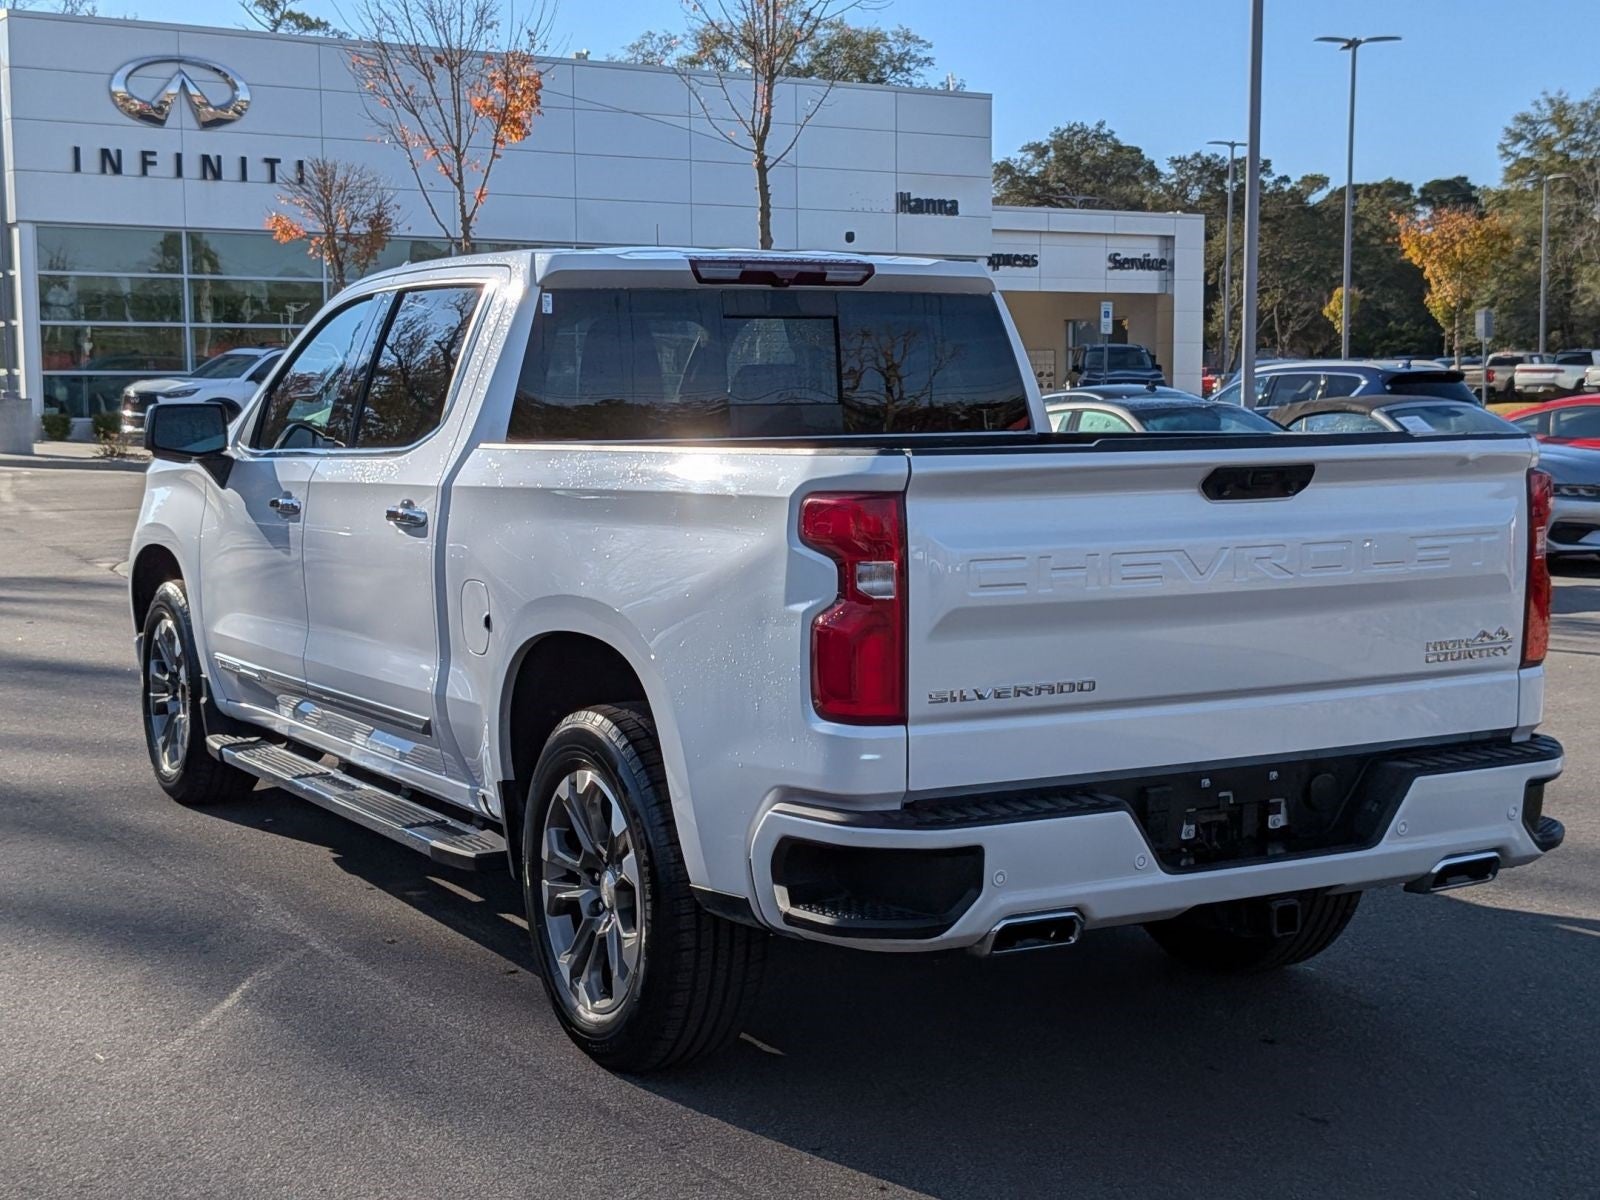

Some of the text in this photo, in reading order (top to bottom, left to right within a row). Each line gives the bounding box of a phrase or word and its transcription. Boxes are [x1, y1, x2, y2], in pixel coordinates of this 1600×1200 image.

[73, 145, 304, 184] INFINITI
[986, 253, 1039, 272] xpress
[1108, 252, 1168, 271] Service
[967, 530, 1502, 597] CHEVROLET
[1425, 638, 1473, 653] HIGH
[1425, 644, 1513, 664] COUNTRY
[928, 679, 1097, 704] SILVERADO
